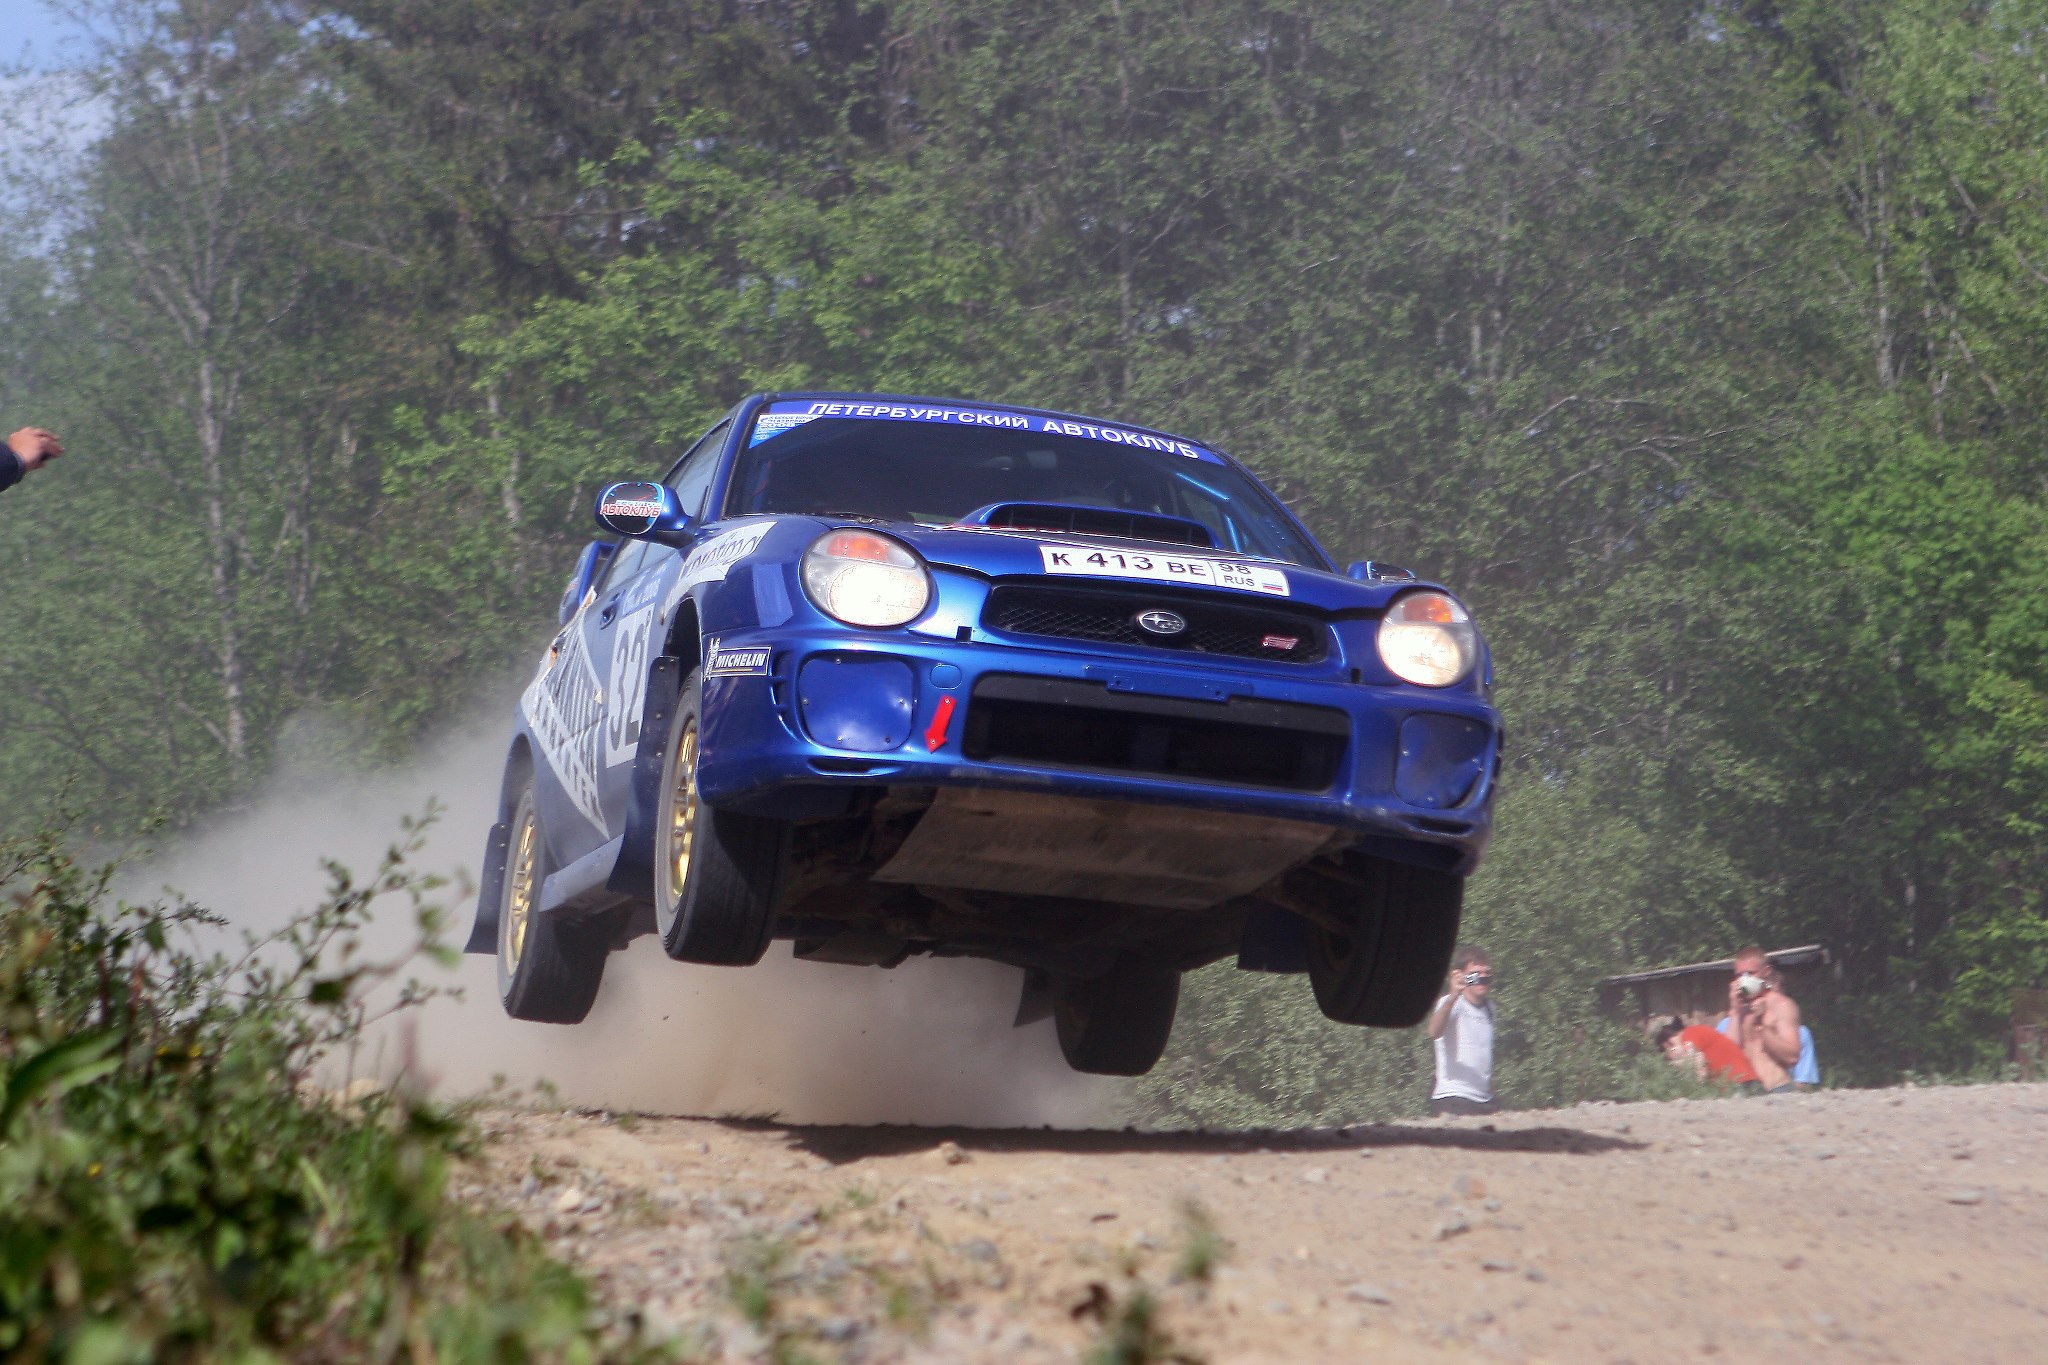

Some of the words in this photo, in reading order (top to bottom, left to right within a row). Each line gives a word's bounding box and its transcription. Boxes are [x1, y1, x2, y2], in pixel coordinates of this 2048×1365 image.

[808, 402, 1029, 429] ПЕТЕРБУРГСКИЙ
[1042, 419, 1199, 459] АВТОКЛУБ
[601, 503, 661, 517] АВТОКЛУБ
[1086, 552, 1154, 571] 413
[1224, 575, 1255, 587] RUS
[715, 653, 767, 668] MICHELIN
[610, 623, 645, 752] 32
